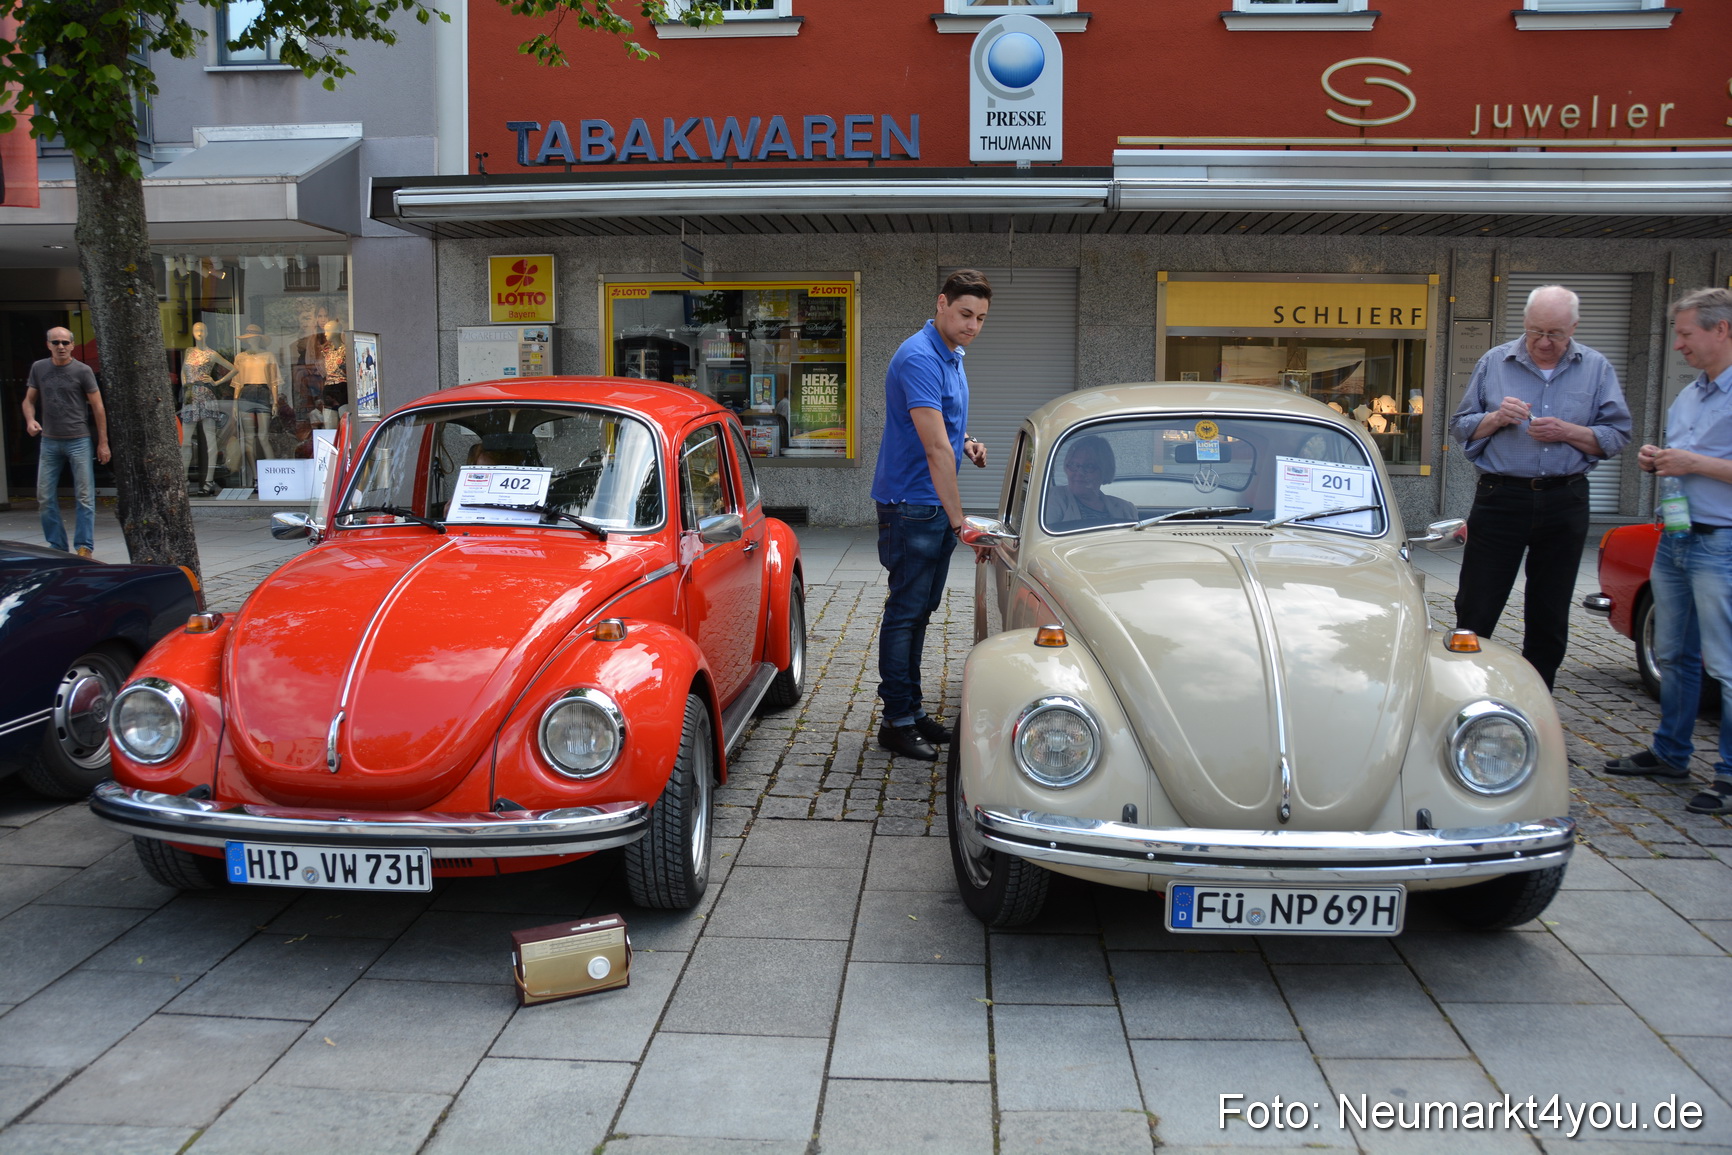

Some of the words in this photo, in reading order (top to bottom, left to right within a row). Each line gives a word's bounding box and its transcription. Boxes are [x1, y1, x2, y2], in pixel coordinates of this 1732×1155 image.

[985, 109, 1047, 128] PRESSE
[1471, 92, 1675, 136] juwelier
[506, 113, 921, 166] TABAKWAREN
[980, 134, 1052, 152] THUMANN
[622, 288, 647, 296] LOTTO
[821, 286, 848, 295] LOTTO
[497, 291, 547, 306] LOTTO
[508, 310, 536, 320] Bayern
[1274, 305, 1423, 326] SCHLIERF
[463, 331, 516, 342] ZIGARETTEN
[801, 373, 839, 387] HERZ
[801, 386, 839, 395] SCHLAG
[801, 395, 838, 405] FINALE
[264, 467, 296, 475] SHORTS
[499, 477, 532, 490] 402
[1322, 474, 1351, 491] 201
[233, 866, 242, 876] D
[247, 846, 299, 882] HIP
[320, 850, 357, 886] VW
[364, 852, 426, 887] 73H
[1178, 911, 1187, 922] D
[1195, 889, 1244, 925] FÜ
[1270, 893, 1317, 926] NP
[1322, 894, 1396, 927] 69H
